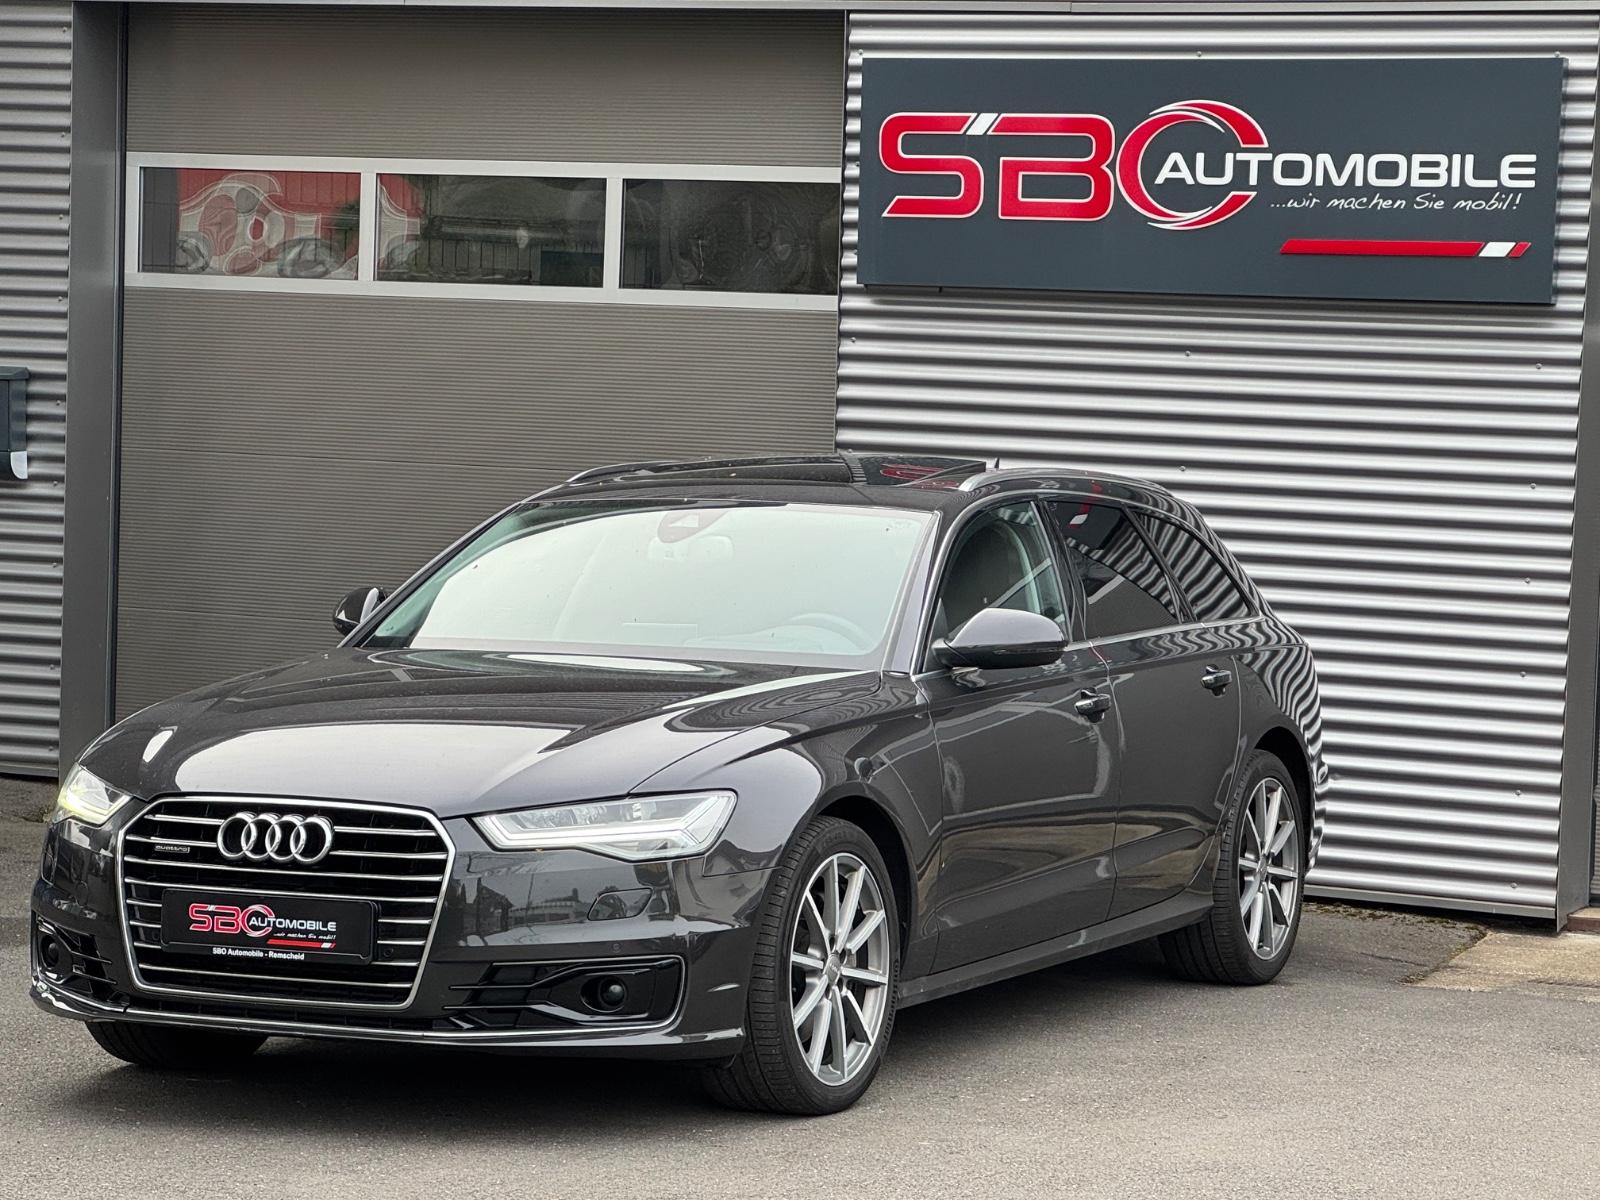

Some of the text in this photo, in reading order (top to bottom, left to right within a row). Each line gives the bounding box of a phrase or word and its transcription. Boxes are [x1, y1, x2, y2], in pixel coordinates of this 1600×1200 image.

[878, 99, 1538, 231] SBO AUTOMOBILE
[1326, 193, 1406, 210] machen
[1413, 192, 1445, 210] Sie
[1452, 191, 1522, 212] mobil!
[188, 903, 337, 938] SBO AUTOMOBILE
[212, 947, 226, 955] SBO
[227, 948, 264, 958] Automobile
[268, 951, 305, 960] Remscheid
